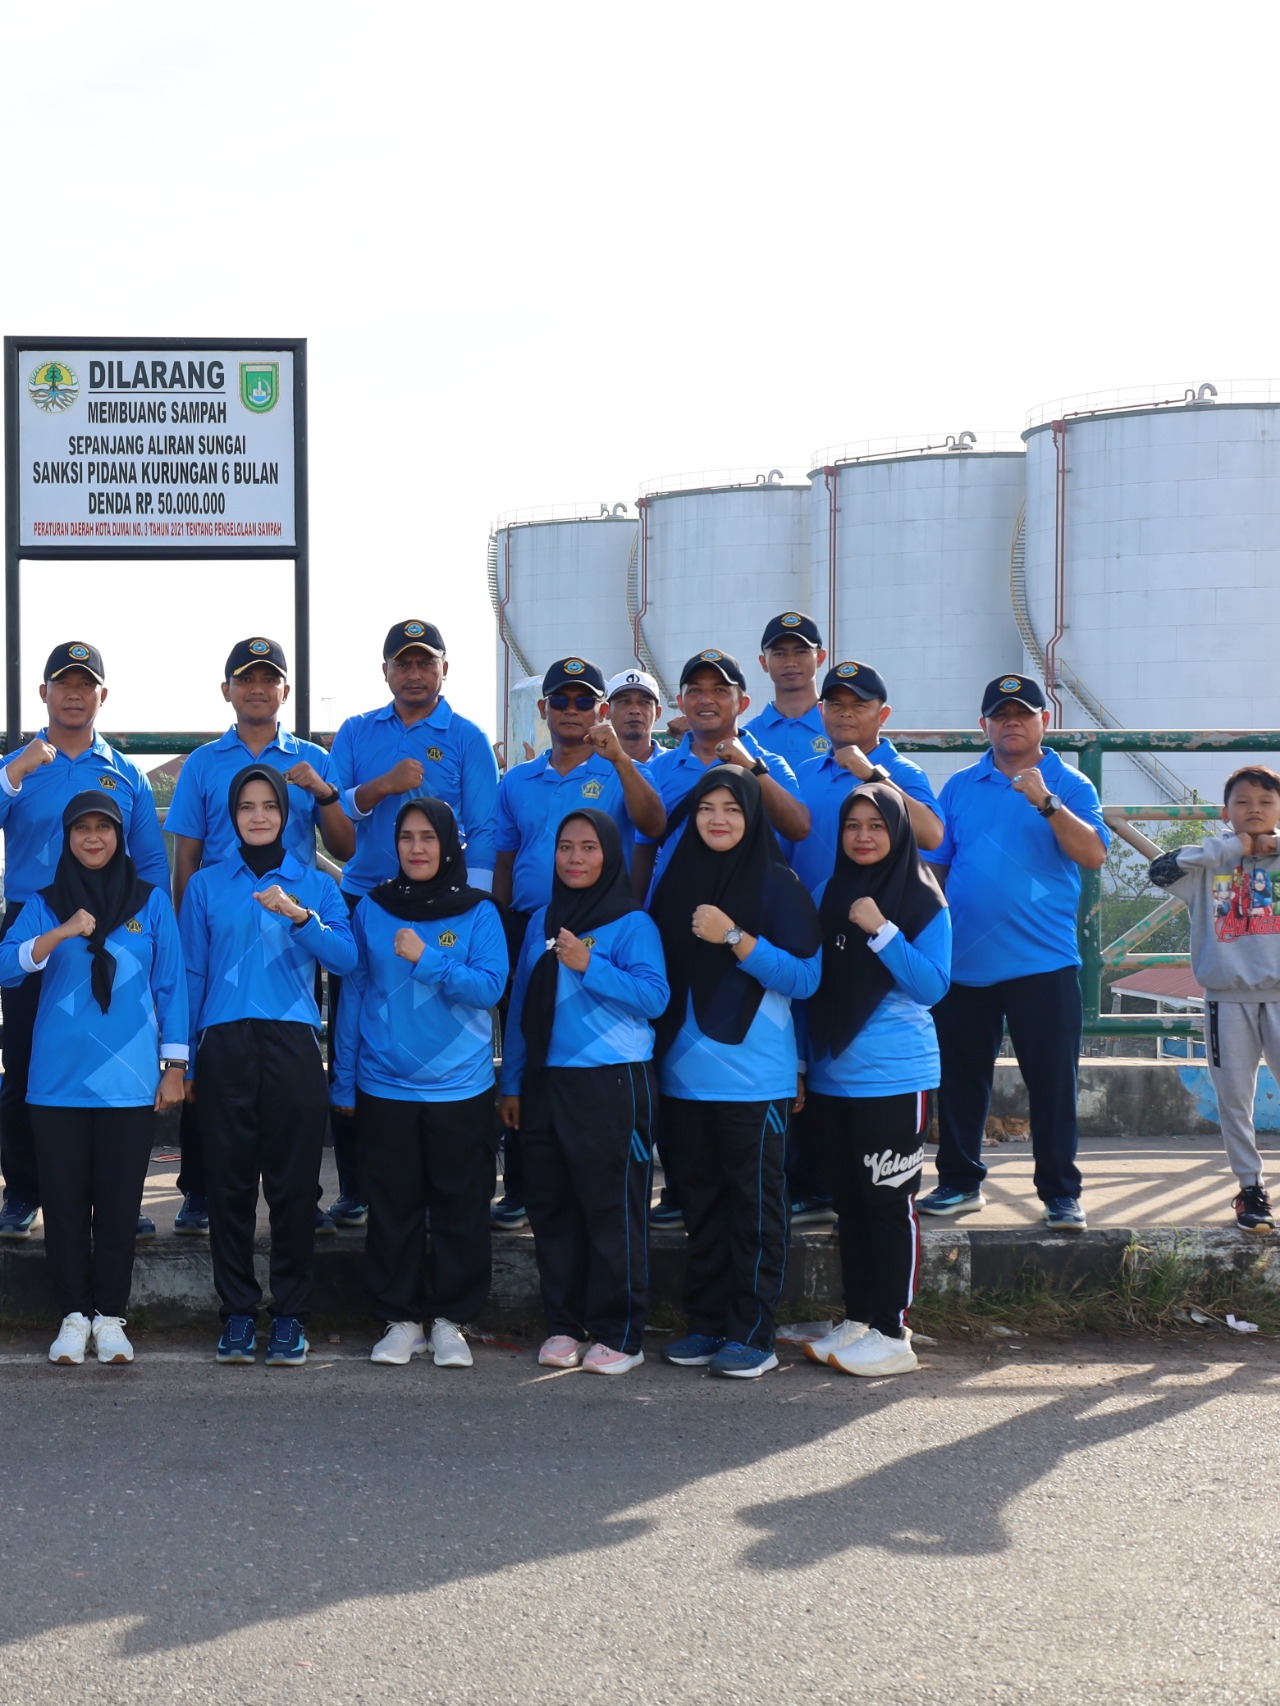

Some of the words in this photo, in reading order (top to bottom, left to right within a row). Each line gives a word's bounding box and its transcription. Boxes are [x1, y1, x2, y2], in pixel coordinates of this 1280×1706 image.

[89, 360, 225, 390] DILARANG
[87, 401, 167, 424] MEMBUANG
[170, 401, 227, 424] SAMPAH
[68, 435, 144, 455] SEPANJANG
[147, 435, 194, 455] ALIRAN
[198, 434, 246, 455] SUNGAI
[32, 461, 83, 484] SANKSI
[87, 461, 138, 484] PIDANA
[141, 461, 218, 485] KURUNGAN
[221, 461, 230, 485] 6
[233, 461, 279, 485] BULAN
[88, 491, 132, 515] DENDA
[135, 492, 154, 515] RP.
[157, 491, 226, 515] 50.000.000
[33, 521, 69, 537] PERATURAN
[70, 521, 94, 537] DAERAH
[95, 521, 111, 537] KOTA
[112, 521, 132, 537] DUMAI
[132, 521, 144, 537] NO.
[149, 521, 170, 537] TAHUN
[170, 521, 184, 537] 2021
[185, 521, 213, 537] TENTANG
[214, 521, 257, 537] PENGELOLAAN
[257, 521, 282, 537] SAMPAH
[863, 1146, 924, 1184] Valent
